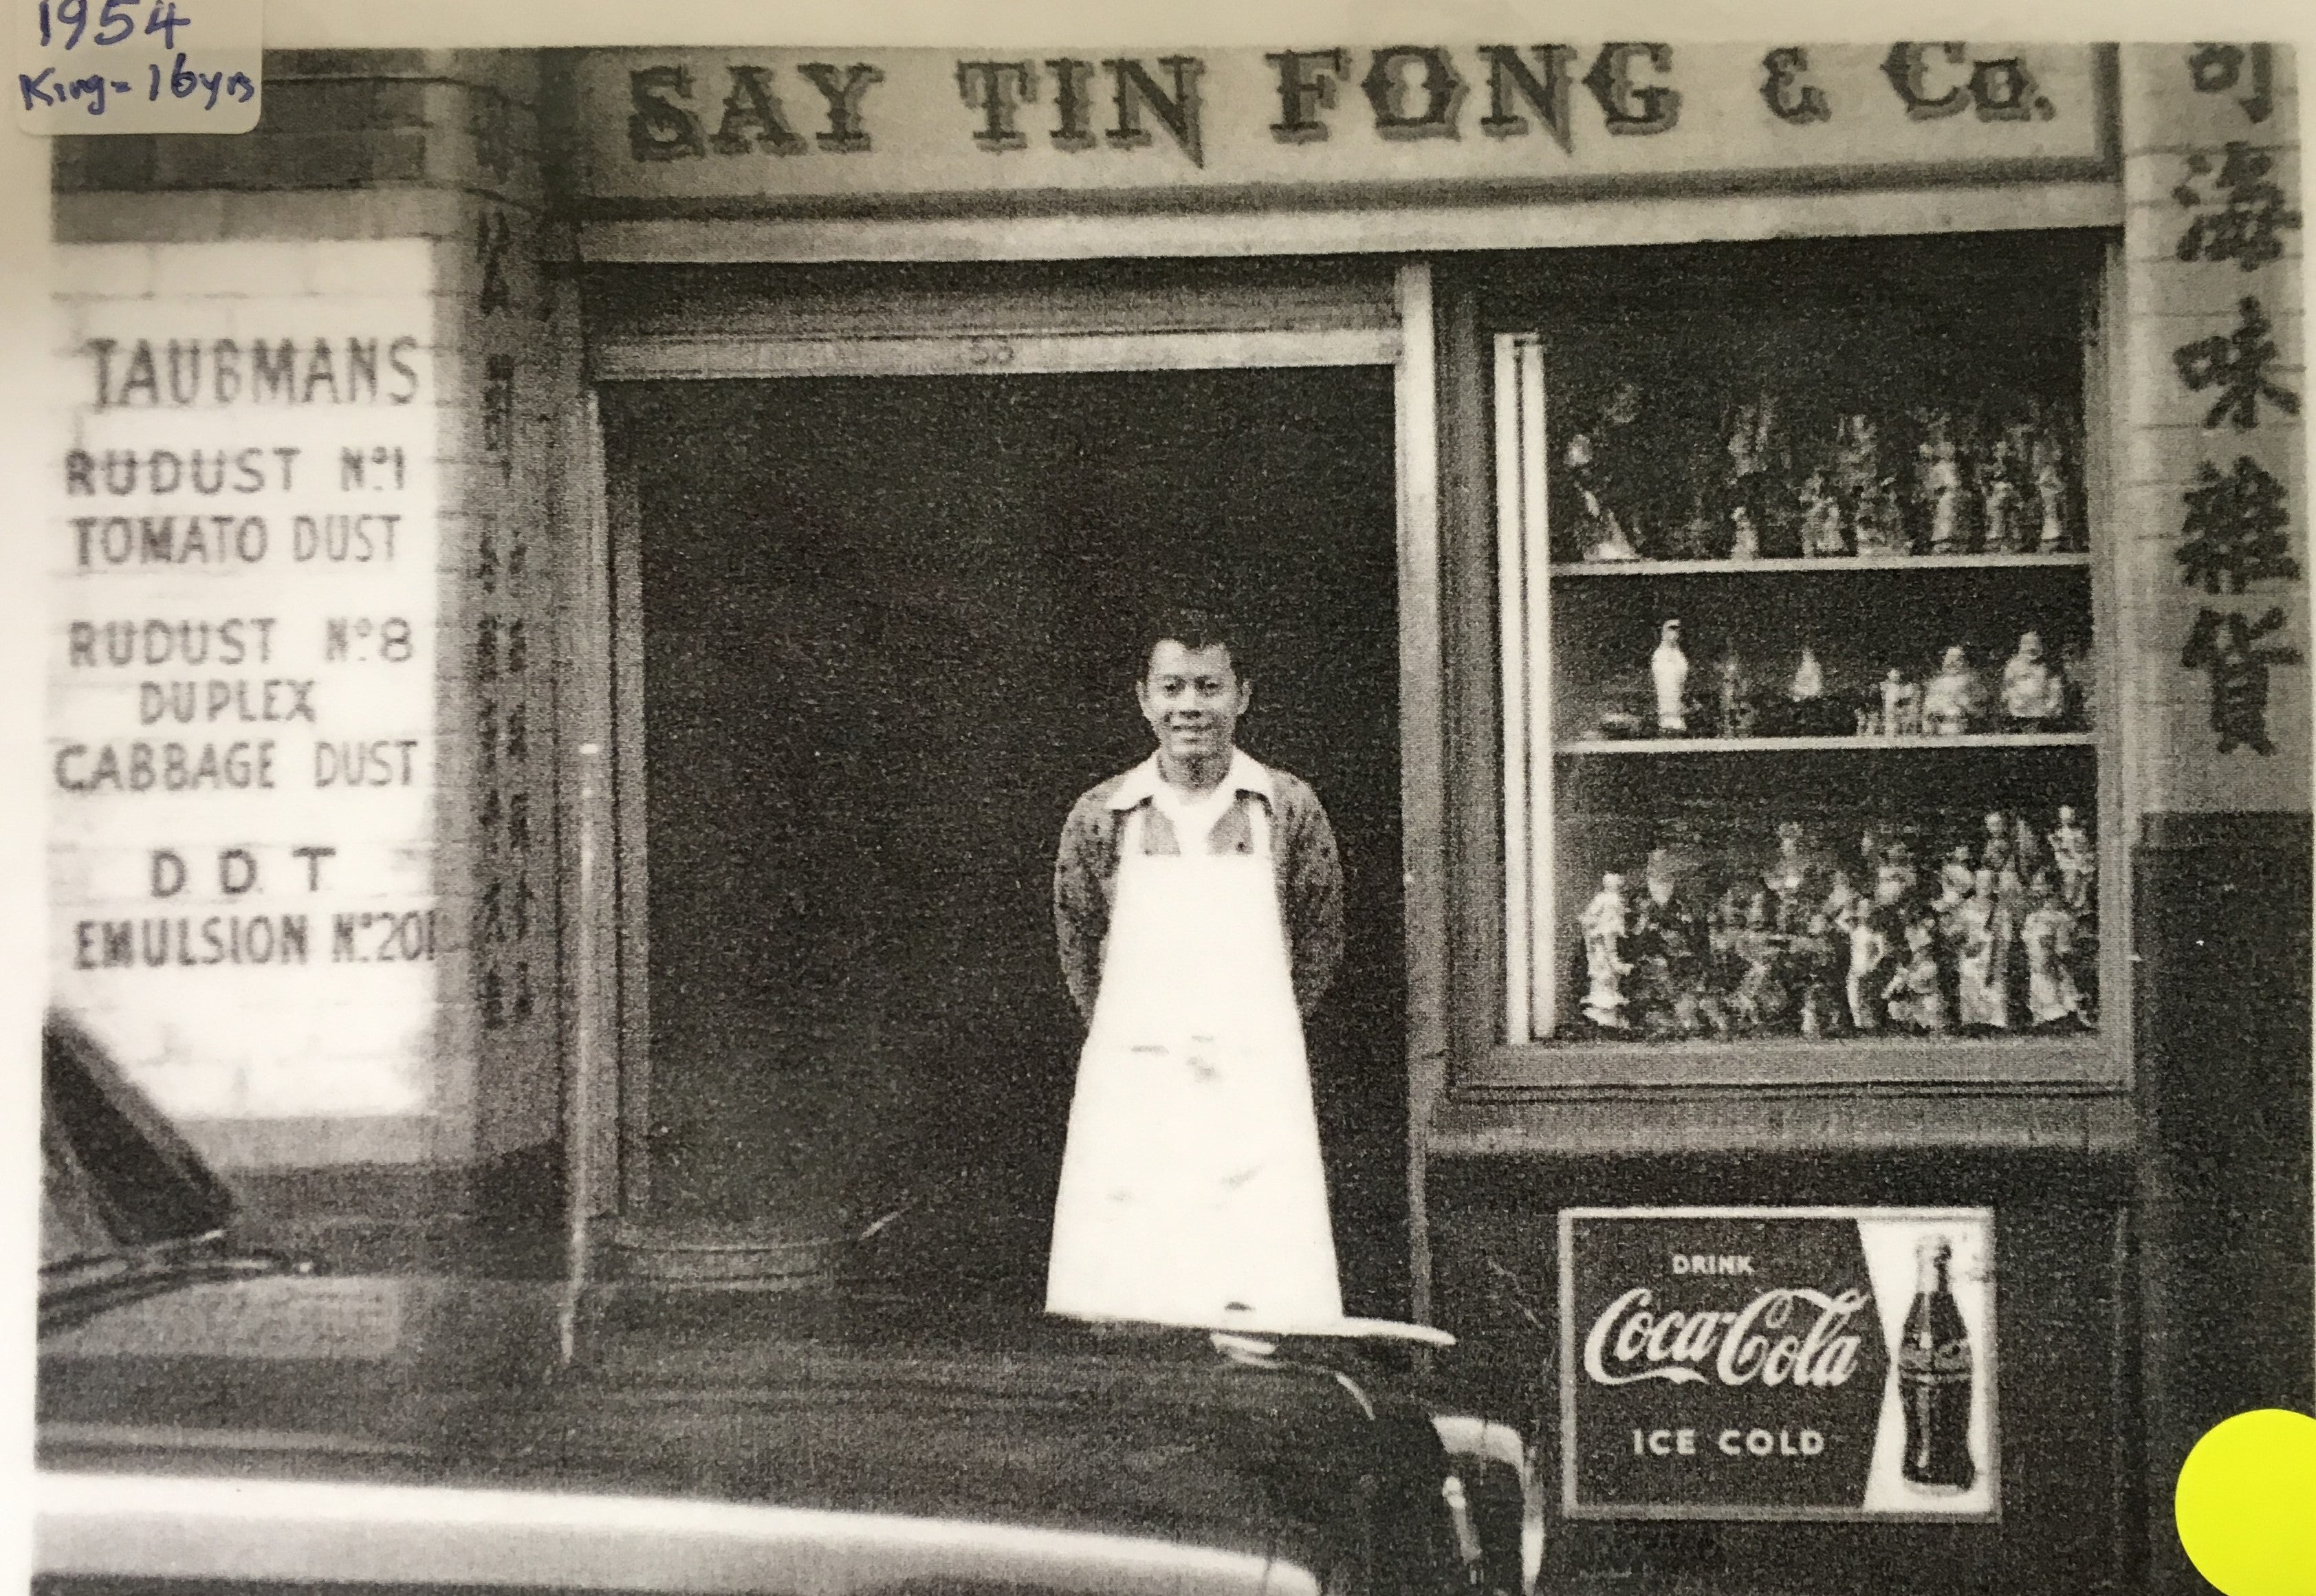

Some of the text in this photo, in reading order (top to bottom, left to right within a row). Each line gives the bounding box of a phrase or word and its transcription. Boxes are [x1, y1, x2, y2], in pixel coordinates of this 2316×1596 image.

[39, 0, 190, 50] 1954
[628, 41, 2056, 170] SAY TIN FONG & Co.
[83, 336, 419, 414] TAUBMANS
[65, 447, 301, 496] RUDUST
[71, 514, 402, 566] TOMATO DUST
[70, 617, 278, 667] RUDUST
[140, 679, 317, 725] DUPLEX
[54, 739, 418, 791] CABBAGE DUST
[74, 913, 309, 970] EMULSION
[1672, 1254, 1754, 1275] DRINK
[1584, 1288, 1872, 1386] Coca-Cola
[1634, 1428, 1825, 1456] ICE COLD
